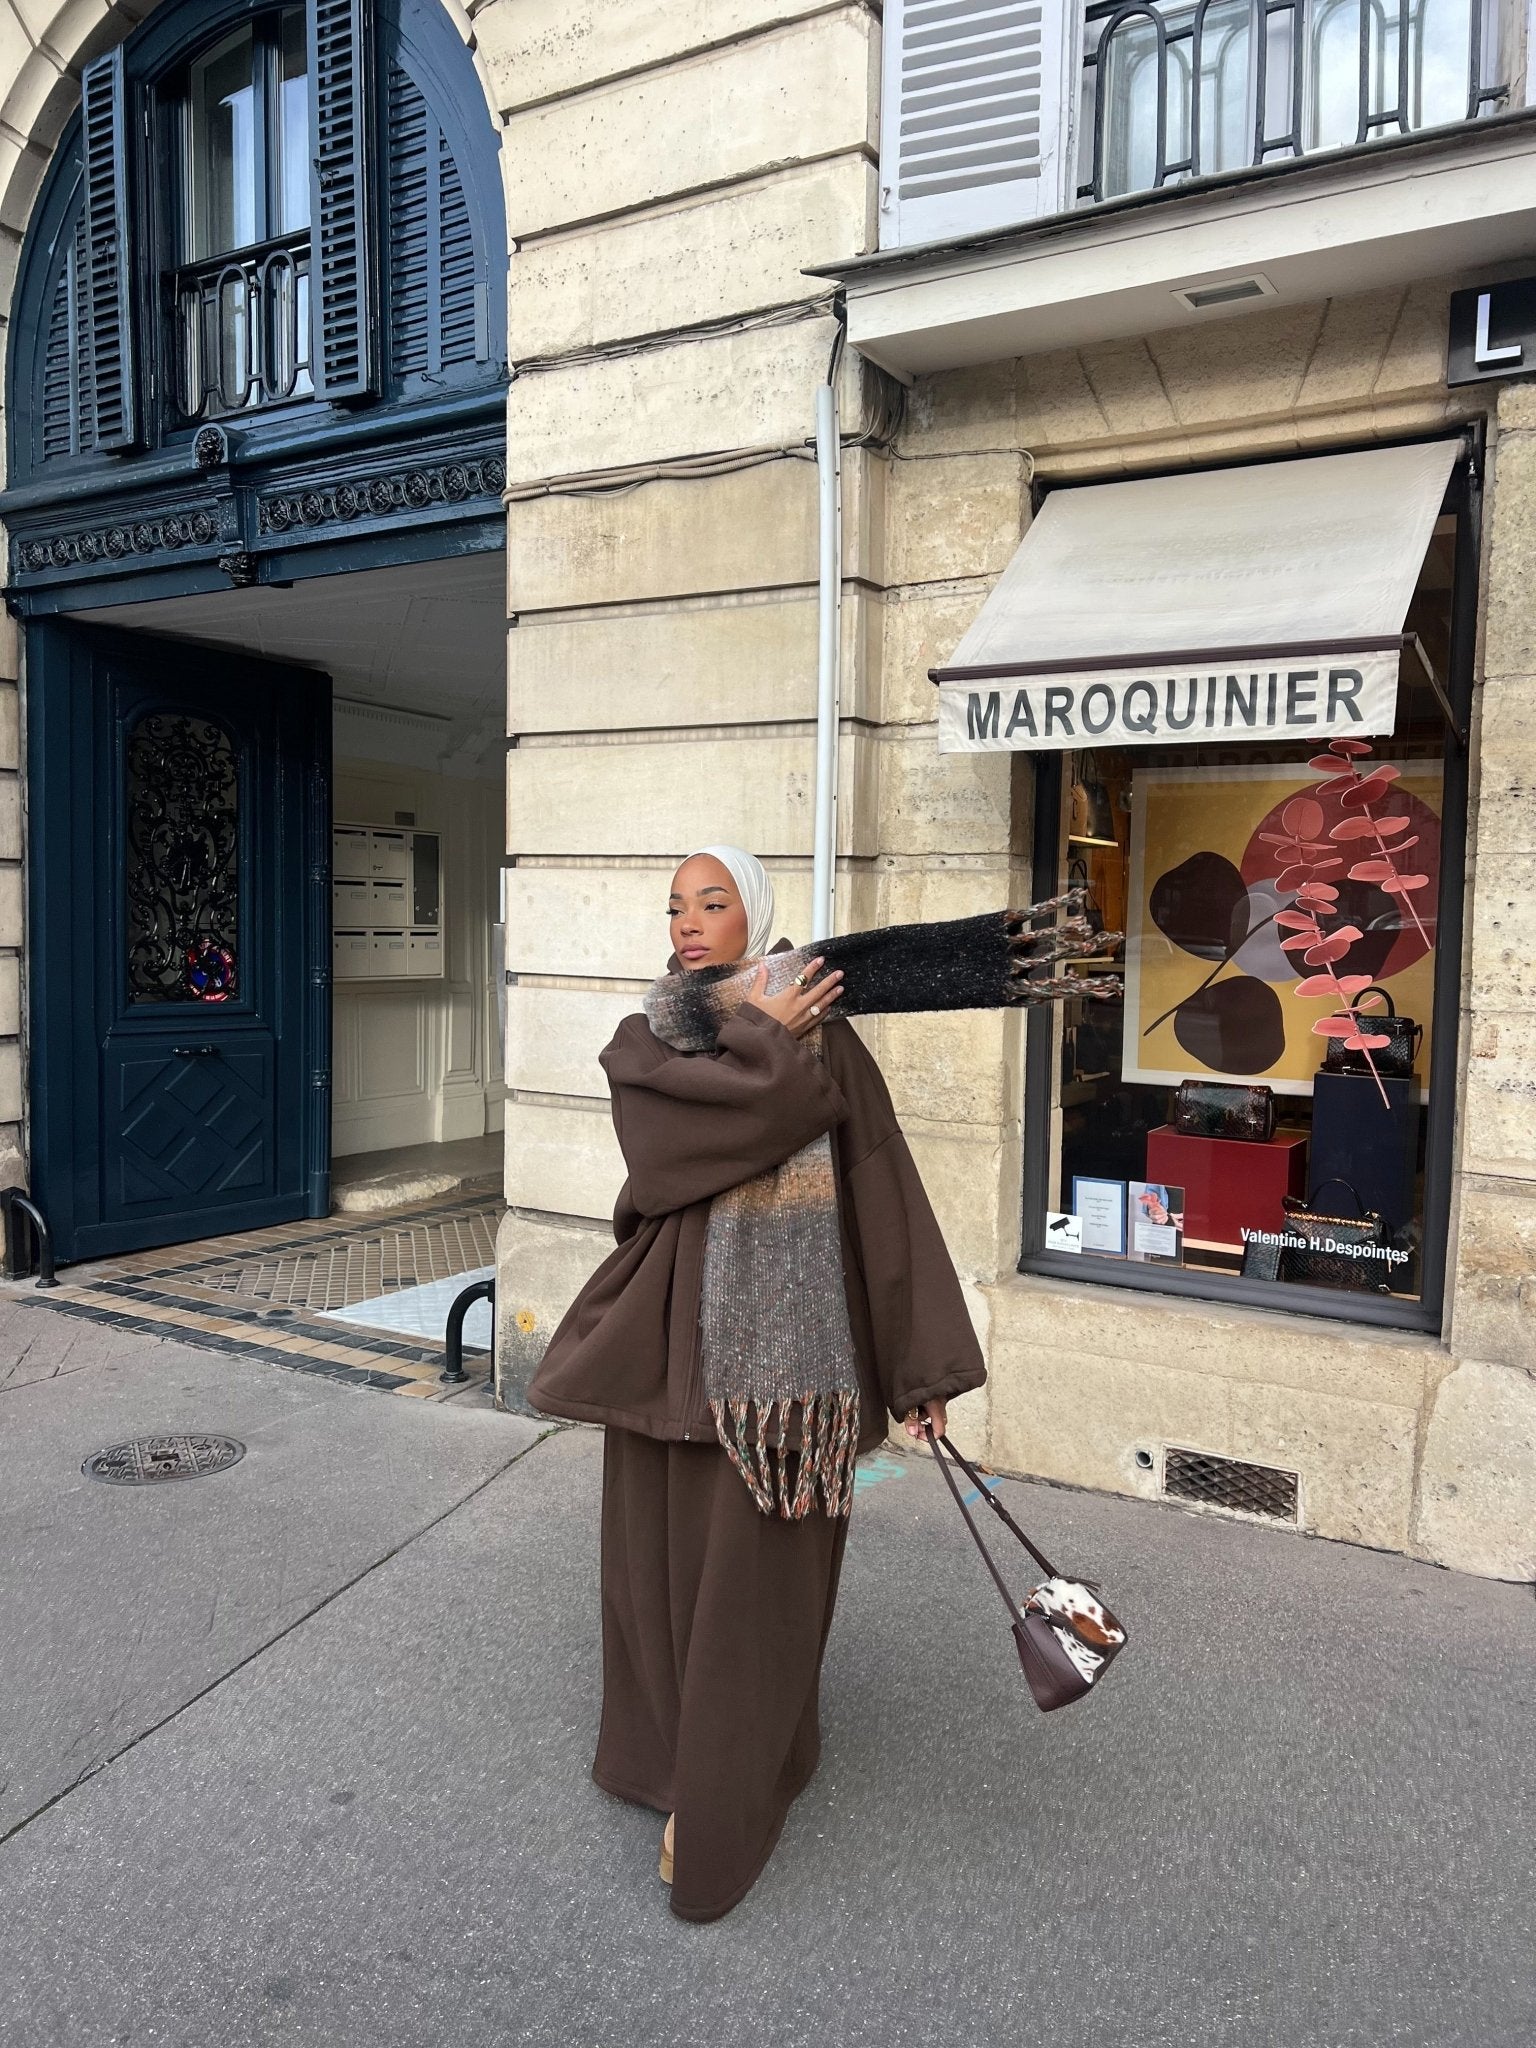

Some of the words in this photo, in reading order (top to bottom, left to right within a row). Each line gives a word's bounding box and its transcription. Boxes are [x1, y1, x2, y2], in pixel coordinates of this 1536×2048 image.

[1475, 293, 1522, 363] L
[966, 668, 1364, 740] MAROQUINIER
[1240, 1227, 1307, 1249] Valentine
[1309, 1236, 1409, 1263] H.Despointes
